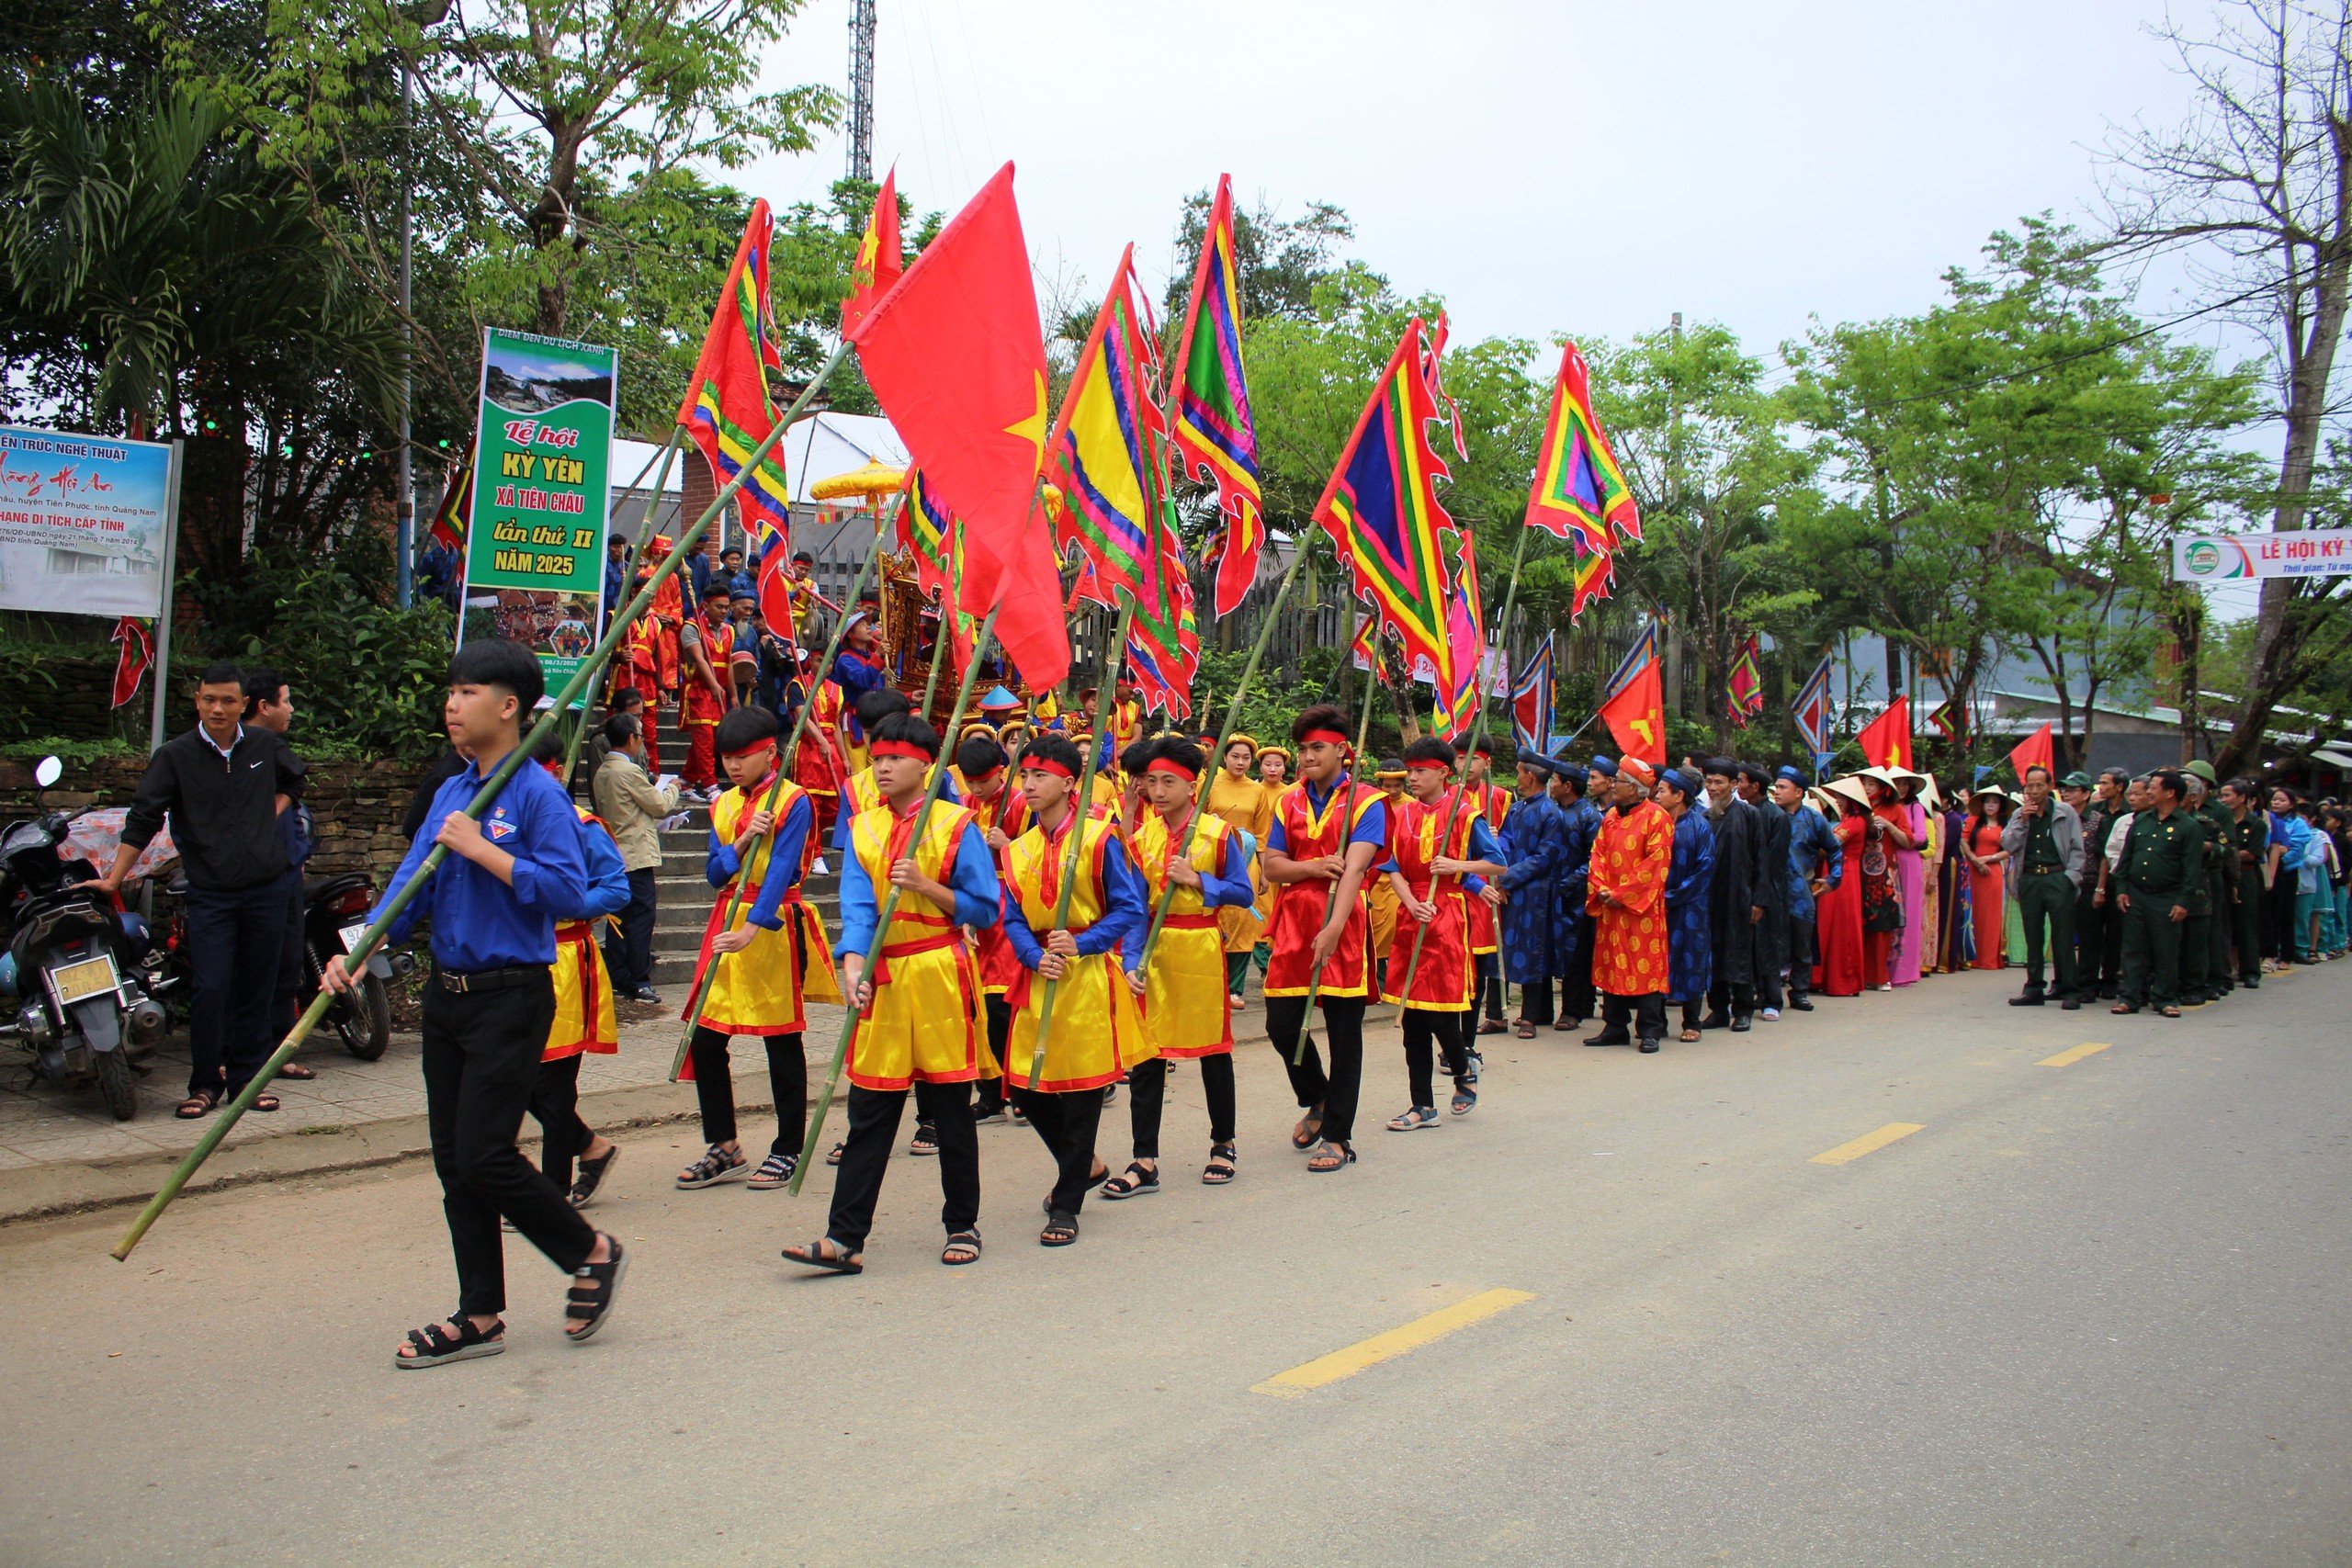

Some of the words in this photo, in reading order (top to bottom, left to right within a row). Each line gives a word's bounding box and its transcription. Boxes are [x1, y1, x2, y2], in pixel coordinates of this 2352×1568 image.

[504, 420, 538, 446] Lễ
[537, 425, 579, 448] hội
[21, 438, 52, 453] TRÚC
[56, 443, 88, 458] NGHỆ
[91, 446, 128, 462] THUẬT
[502, 449, 537, 479] KỲ
[541, 454, 584, 485] YÊN
[495, 484, 514, 507] XÃ
[518, 488, 548, 511] TIÊN
[549, 491, 584, 514] CHÂU
[32, 514, 43, 525] DI
[492, 517, 528, 544] lần
[531, 525, 567, 547] thứ
[571, 528, 595, 549] II
[494, 548, 534, 572] NĂM
[535, 553, 574, 576] 2025
[2261, 537, 2280, 559] LỄ
[2287, 539, 2315, 561] HỘI
